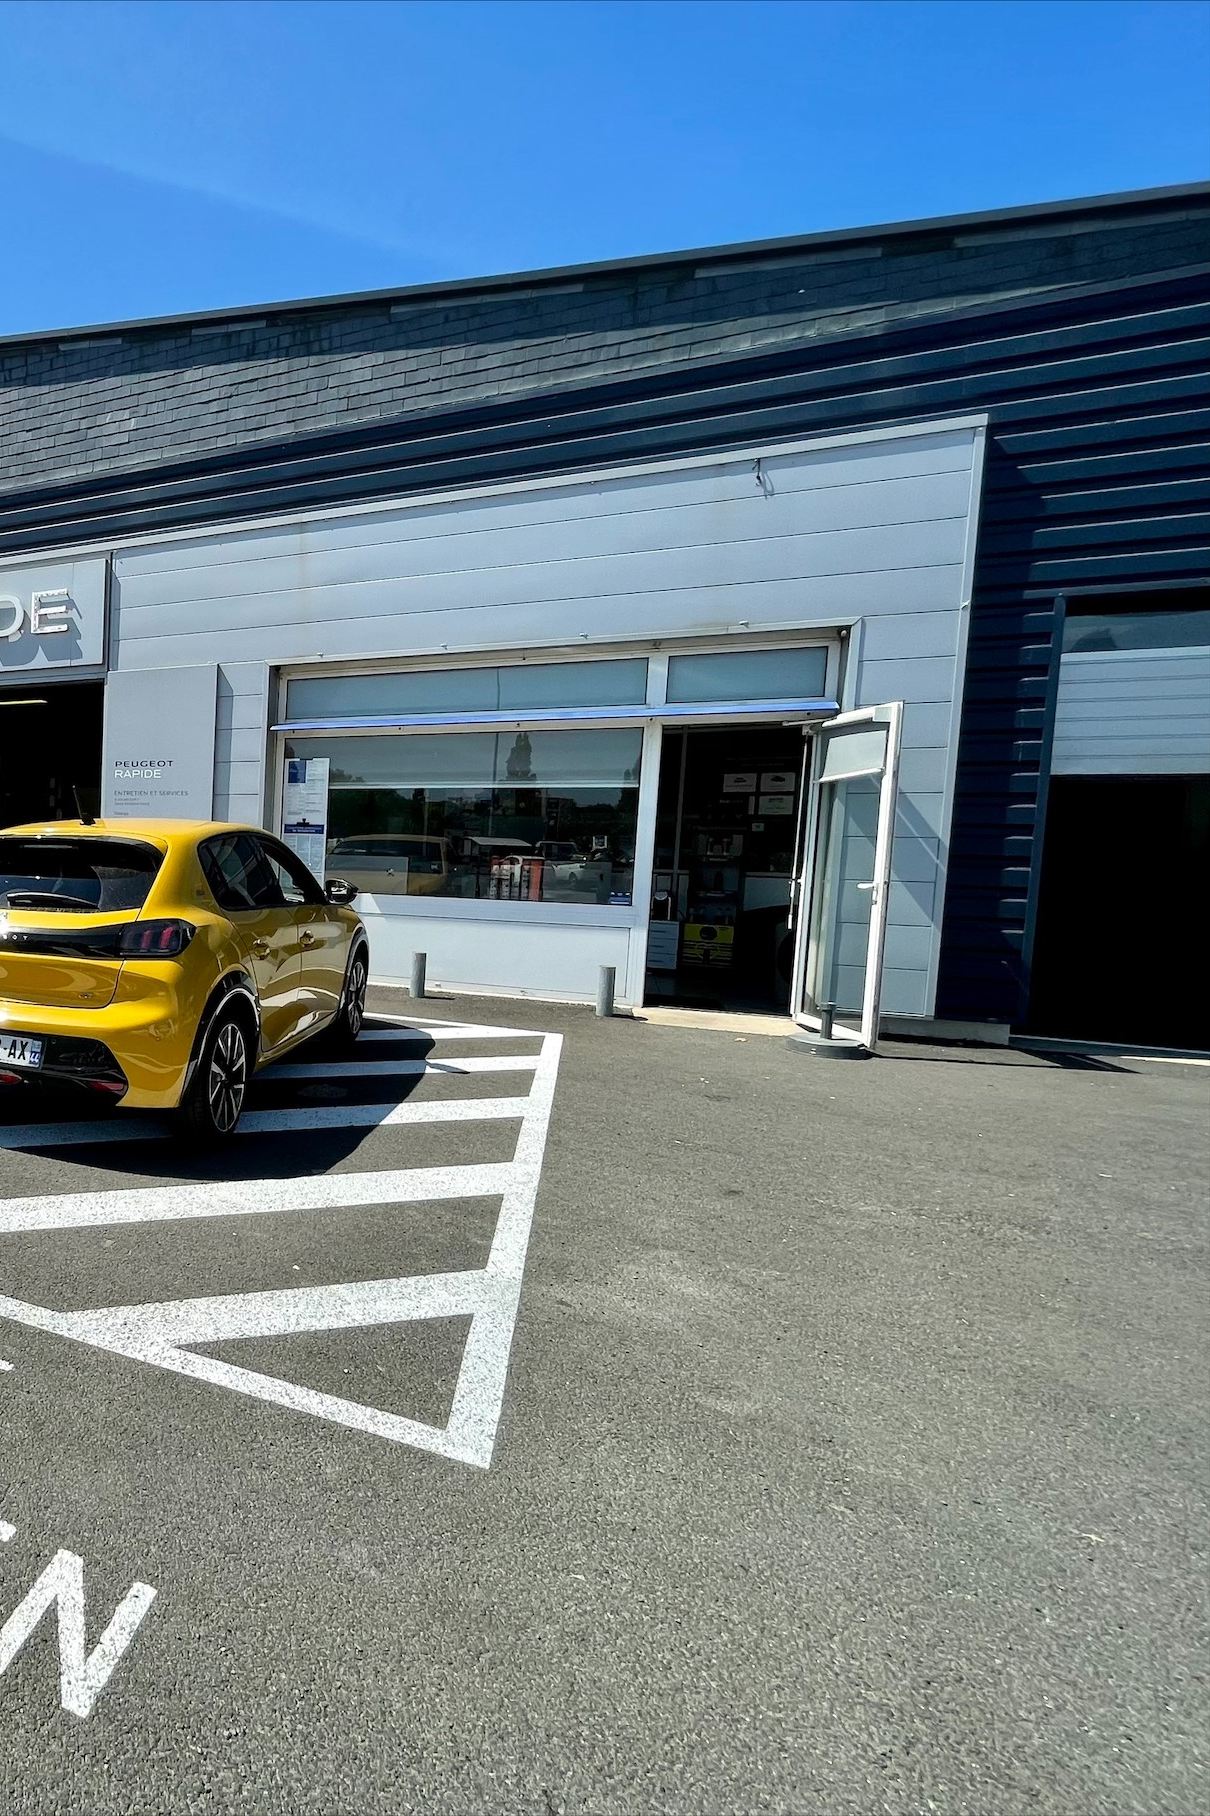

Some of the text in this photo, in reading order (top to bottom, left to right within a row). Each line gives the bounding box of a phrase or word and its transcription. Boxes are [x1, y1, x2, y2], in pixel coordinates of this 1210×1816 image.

[115, 760, 174, 768] PEUGEOT
[114, 769, 162, 779] RAPIDE
[30, 1053, 40, 1063] 44
